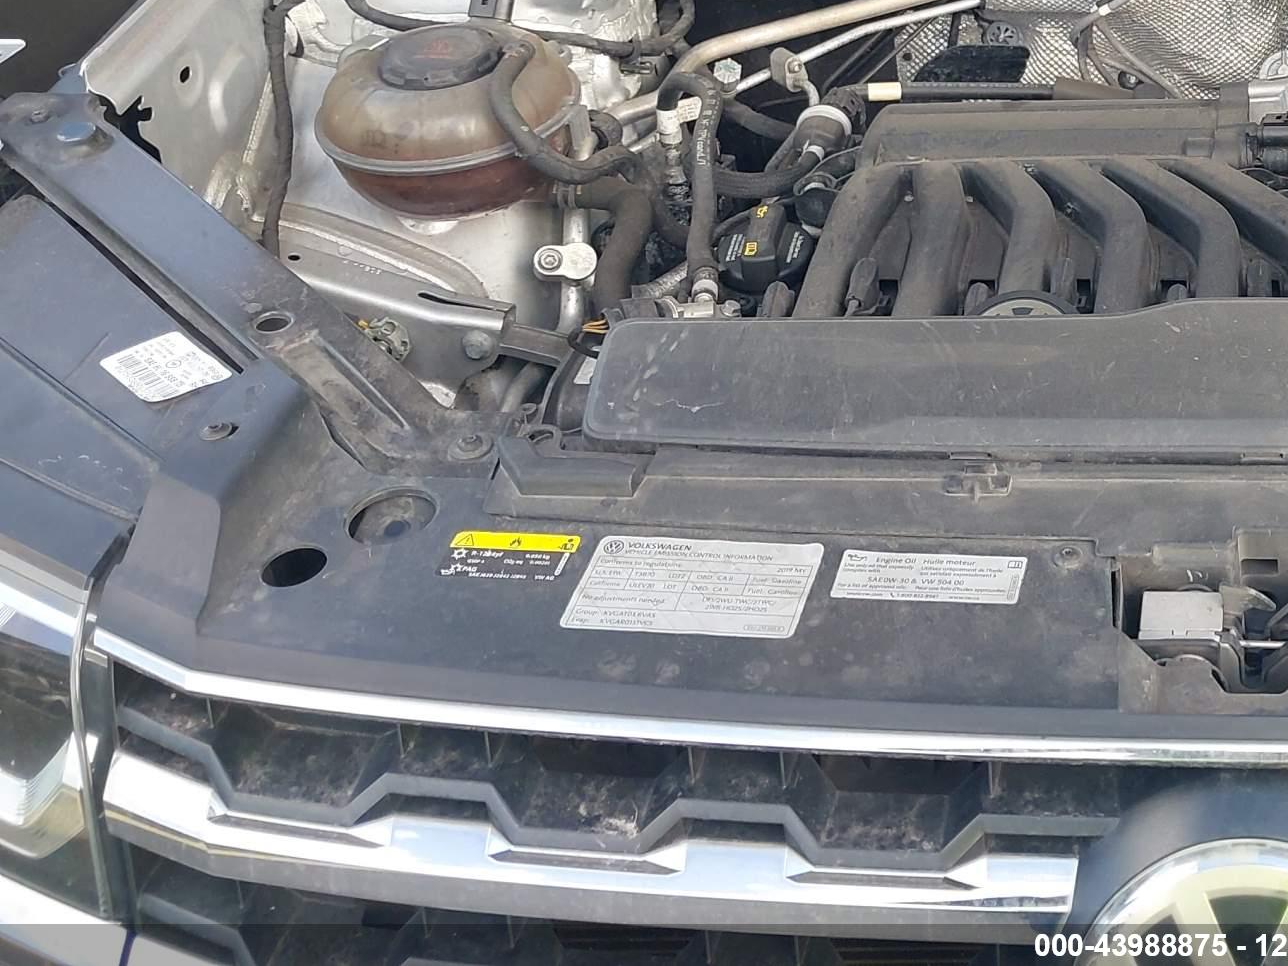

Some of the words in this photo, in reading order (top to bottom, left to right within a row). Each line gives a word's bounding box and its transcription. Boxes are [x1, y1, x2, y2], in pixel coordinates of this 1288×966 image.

[628, 541, 692, 551] VOLKSWAGEN
[723, 554, 773, 562] INFORMATION
[876, 557, 903, 566] Engine
